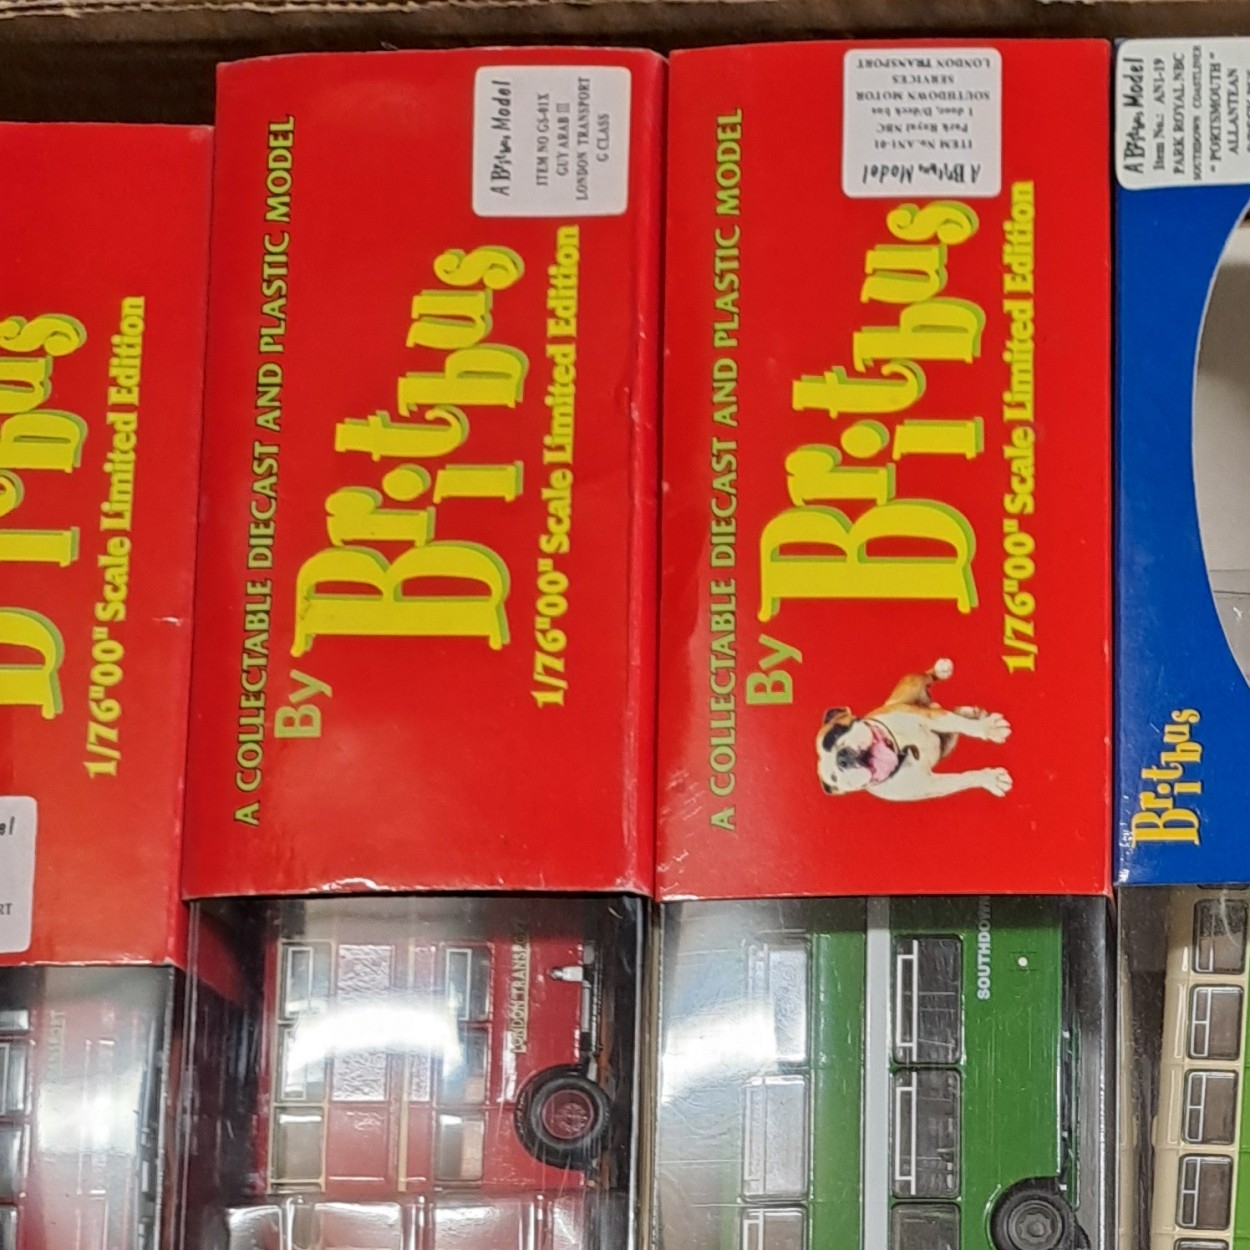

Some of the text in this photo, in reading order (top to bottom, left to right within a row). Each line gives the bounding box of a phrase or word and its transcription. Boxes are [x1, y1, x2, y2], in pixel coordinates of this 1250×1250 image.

[857, 58, 990, 68] LONDON TRANSPORT
[892, 75, 954, 84] SERVICES
[576, 77, 590, 200] LONDON TRANSPORT
[597, 114, 609, 150] CLASS
[547, 225, 579, 337] Edition
[1004, 181, 1035, 294] Edition
[108, 296, 145, 407] Edition
[543, 341, 577, 464] Limited
[1004, 295, 1035, 421] Limited
[290, 245, 529, 657] Britbus
[757, 200, 986, 622] Britbus
[101, 412, 136, 531] Limited
[235, 114, 295, 826] A COLLECTABLE DIECAST AND PLASTIC MODEL
[539, 469, 573, 553] Scale
[710, 108, 743, 830] A COLLECTABLE DIECAST AND PLASTIC MODEL
[1004, 427, 1035, 514] Scale
[97, 537, 130, 622] Scale
[274, 669, 332, 738] By
[746, 634, 802, 704] By
[1131, 709, 1202, 848] Britbus
